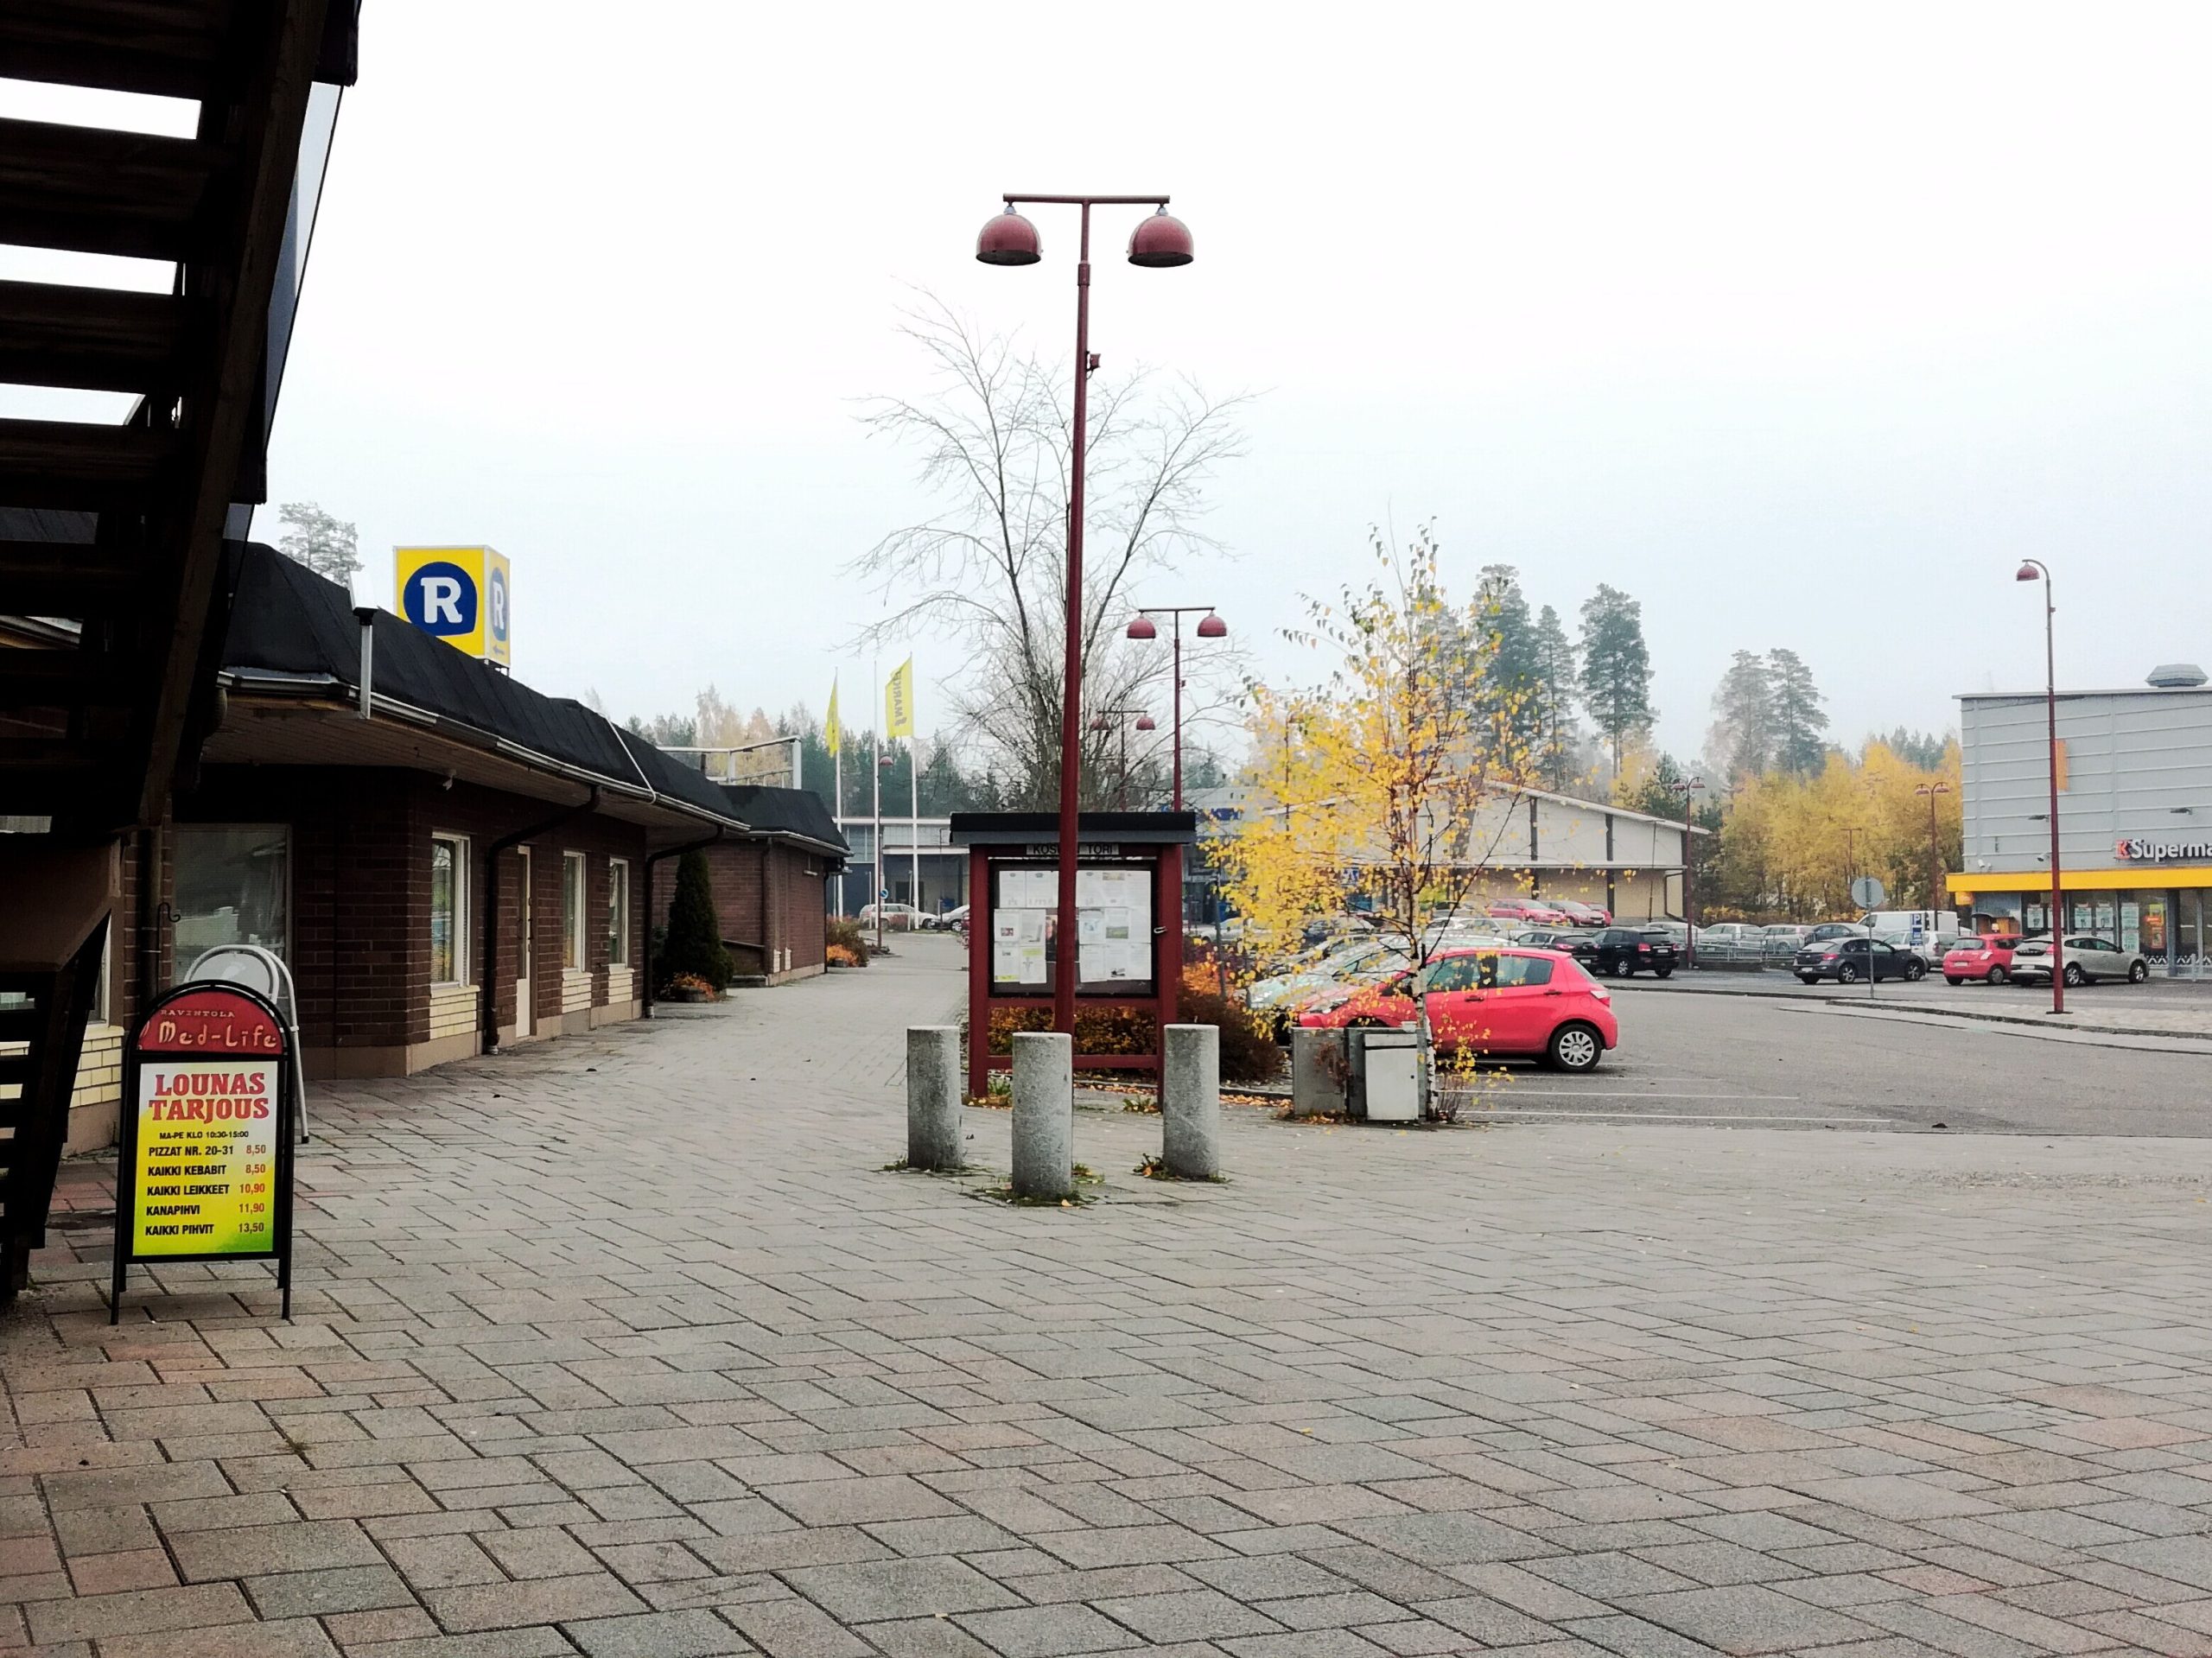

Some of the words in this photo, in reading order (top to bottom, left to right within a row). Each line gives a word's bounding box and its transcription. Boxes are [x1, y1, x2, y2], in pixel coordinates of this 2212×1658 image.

[420, 577, 463, 624] R
[492, 581, 505, 630] R
[1087, 843, 1112, 854] TORI
[160, 1009, 235, 1018] RAVINTOLA
[158, 1020, 277, 1048] Med-Life
[155, 1072, 265, 1096] LOUNAS
[149, 1098, 270, 1124] TARJOUS
[149, 1147, 182, 1157] PIZZAT
[185, 1146, 202, 1156] NR.
[205, 1146, 234, 1156] 20-31
[246, 1145, 266, 1156] 8,50
[148, 1166, 181, 1176] KAIKKI
[184, 1165, 226, 1176] KEBABIT
[245, 1164, 266, 1175] 8,50
[147, 1185, 181, 1196] KAIKKI
[183, 1185, 230, 1196] LEIKKEET
[239, 1183, 265, 1195] 10,90
[146, 1204, 200, 1216] KANAPIHVI
[238, 1203, 264, 1215] 11,90
[145, 1225, 179, 1236] KAIKKI
[181, 1223, 214, 1235] PIHVIT
[238, 1223, 264, 1234] 13,50
